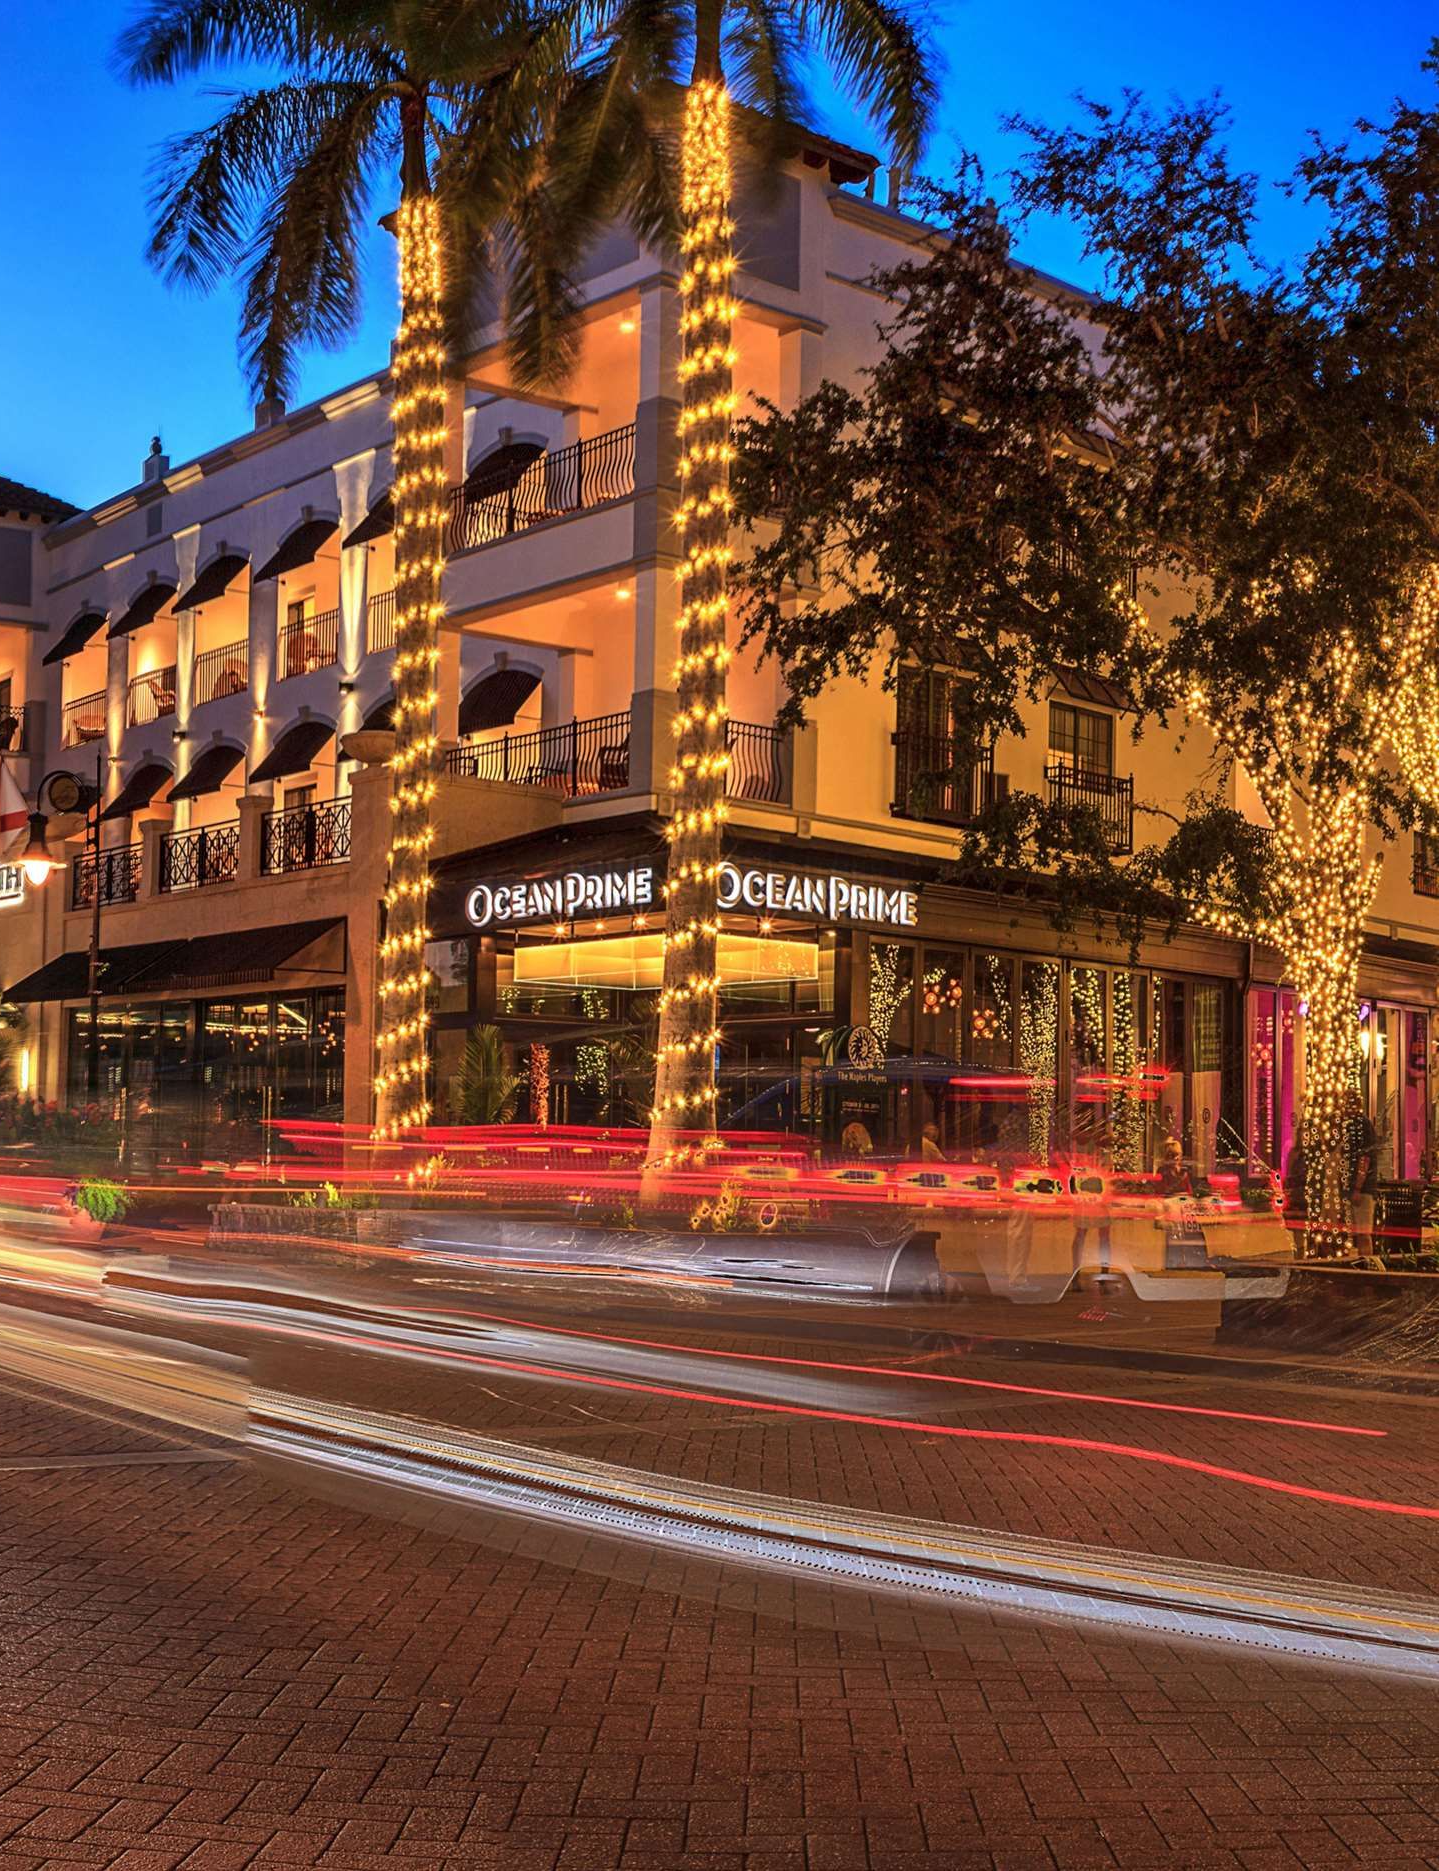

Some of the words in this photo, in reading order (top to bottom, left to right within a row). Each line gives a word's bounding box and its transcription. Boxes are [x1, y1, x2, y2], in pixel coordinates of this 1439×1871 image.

[465, 883, 562, 927] OCEAN
[563, 867, 653, 917] PRIME
[716, 861, 826, 914] OCEAN
[829, 876, 919, 927] PRIME
[837, 1070, 848, 1081] The
[849, 1071, 866, 1085] Naples
